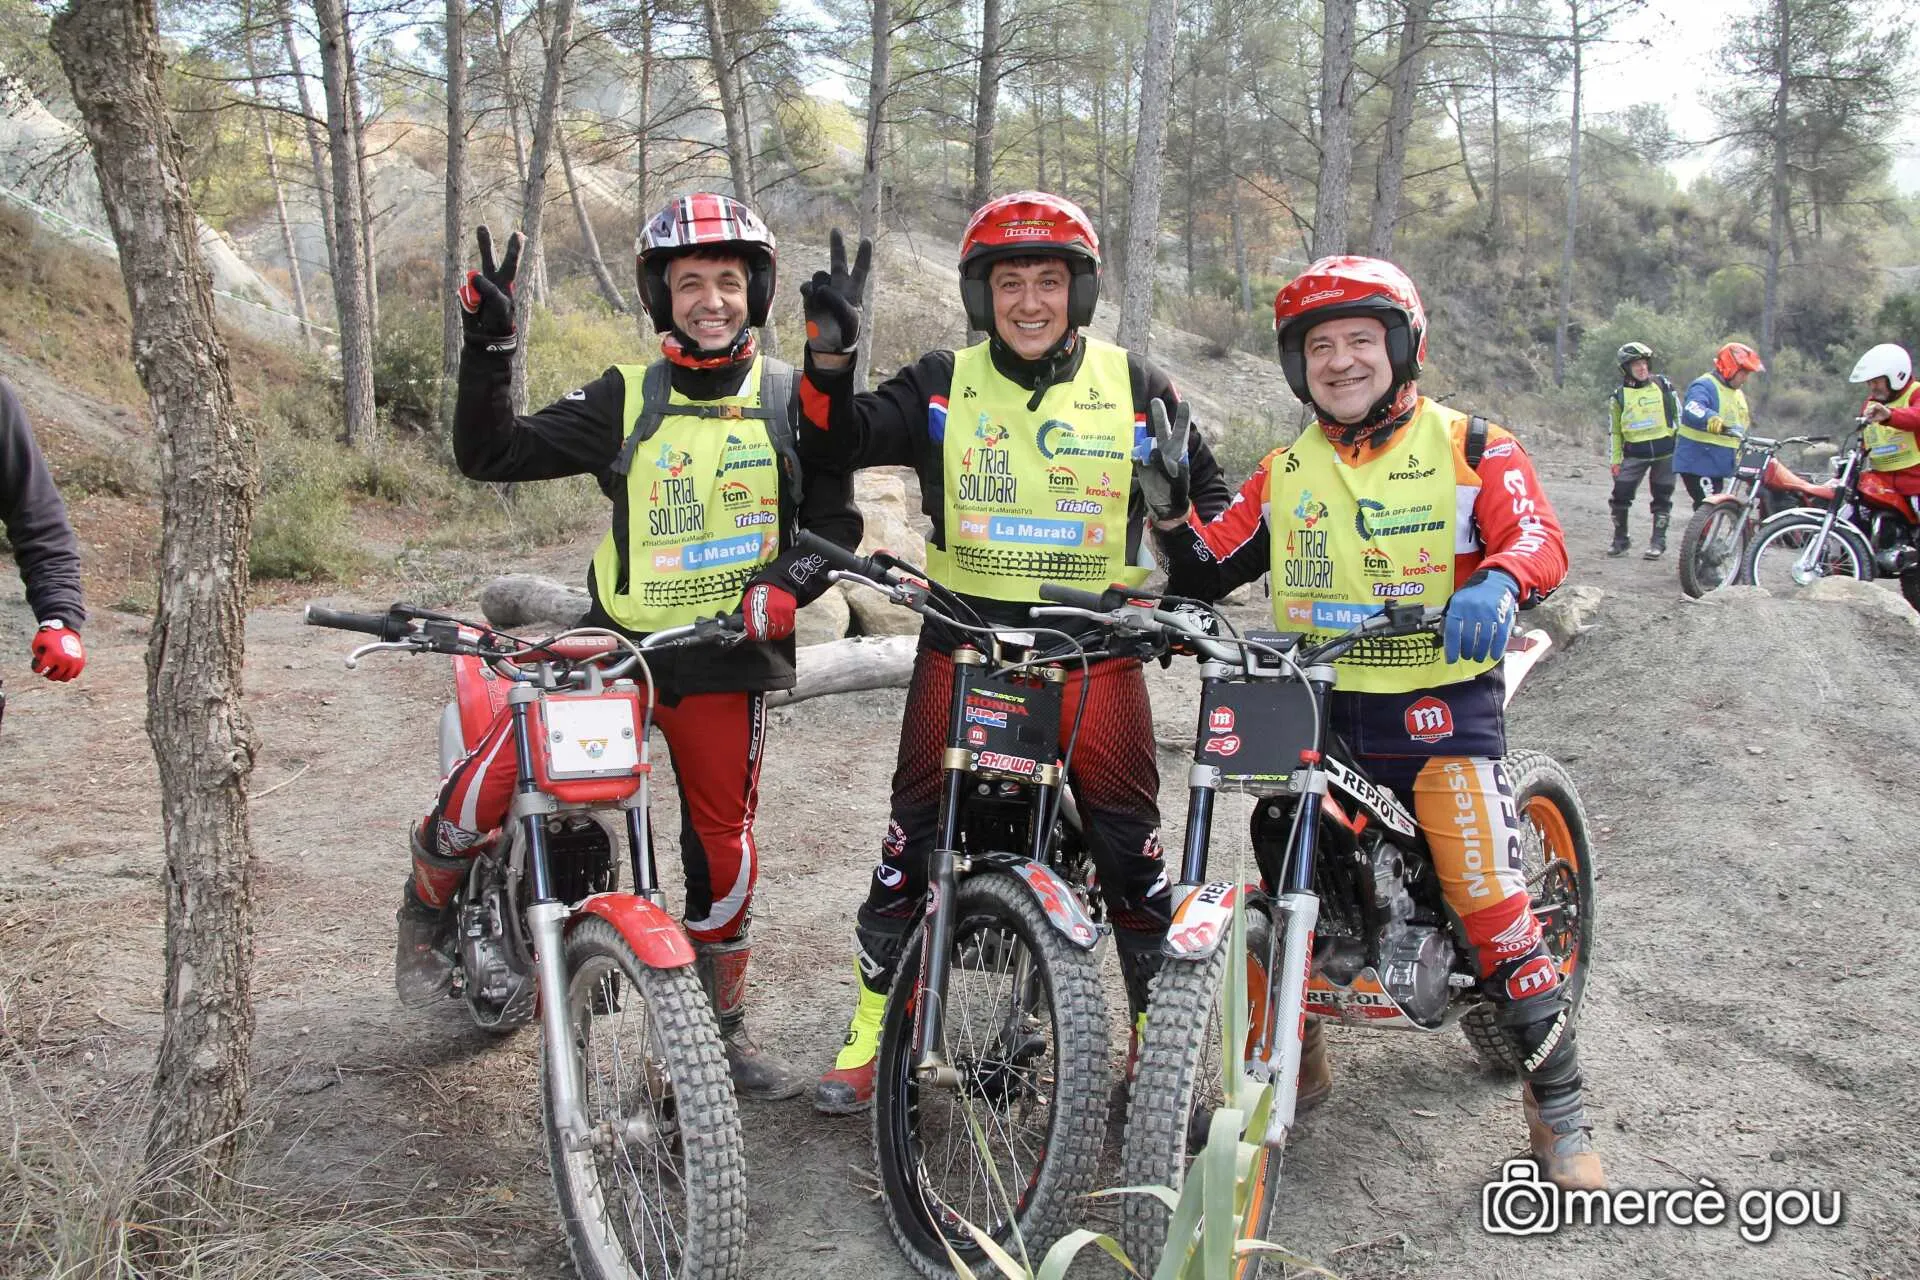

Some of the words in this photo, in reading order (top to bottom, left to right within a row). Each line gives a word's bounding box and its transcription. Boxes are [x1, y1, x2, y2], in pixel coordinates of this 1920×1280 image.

[1055, 448, 1124, 460] PARCMOTOR
[1049, 474, 1073, 485] fcm
[722, 490, 747, 502] fcm
[1056, 499, 1102, 514] TrialGo
[961, 520, 986, 534] Per
[995, 522, 1015, 535] La
[1018, 523, 1077, 540] Marató
[703, 540, 760, 561] Marató
[1364, 556, 1387, 569] fcm
[1372, 582, 1424, 597] TrialGo
[1288, 607, 1312, 618] Per
[1317, 608, 1334, 621] La
[1336, 610, 1371, 624] Mar
[967, 695, 1030, 717] HONDA
[966, 706, 1008, 729] HRC
[978, 751, 1036, 775] SHOWA
[1343, 770, 1395, 825] REPSOL
[1524, 1010, 1567, 1072] RAINERS
